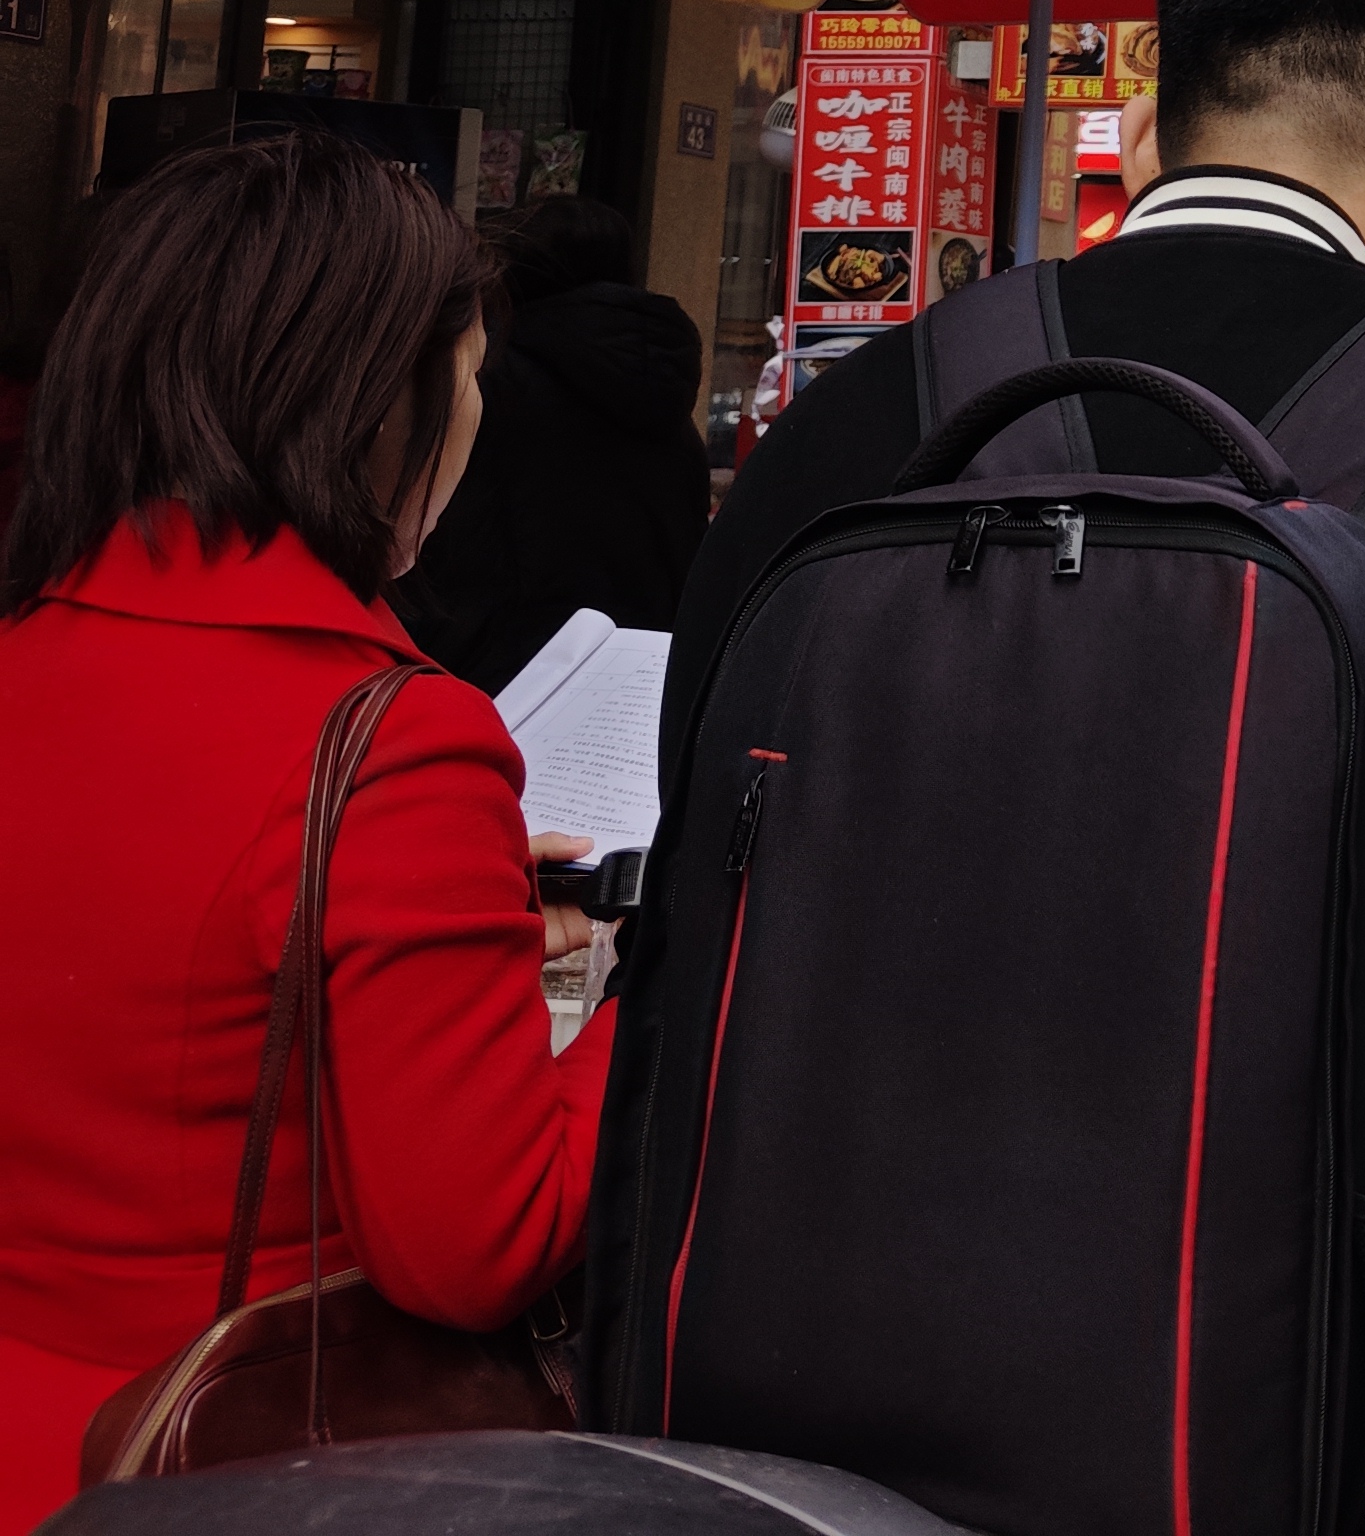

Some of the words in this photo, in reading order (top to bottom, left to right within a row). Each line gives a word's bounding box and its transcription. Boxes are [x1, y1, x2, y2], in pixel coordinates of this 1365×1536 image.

[820, 35, 921, 49] 15559109071
[811, 89, 889, 226] 咖喱牛排
[882, 92, 913, 224] 正宗闽南味
[968, 104, 986, 231] 正宗闽南味
